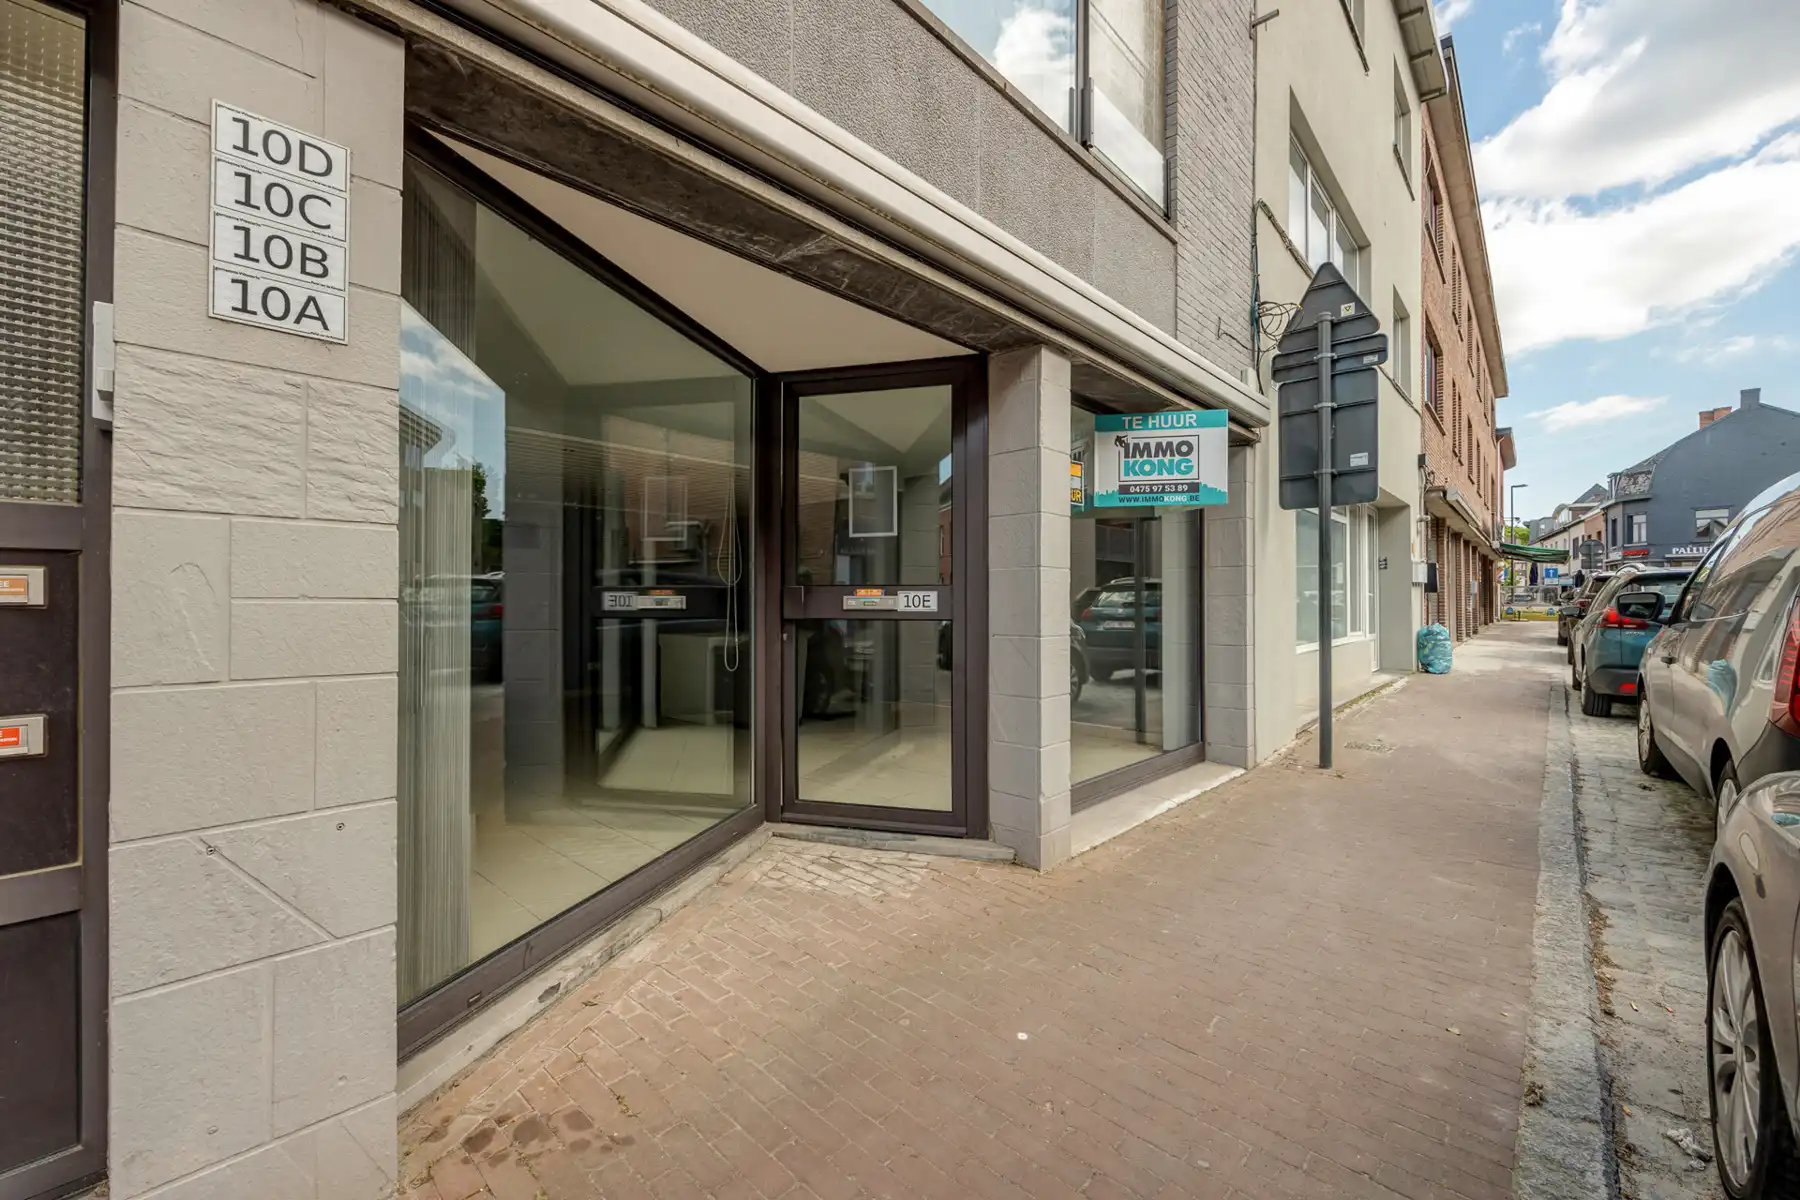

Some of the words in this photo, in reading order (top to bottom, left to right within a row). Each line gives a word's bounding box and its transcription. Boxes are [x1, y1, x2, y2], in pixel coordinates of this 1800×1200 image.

[232, 117, 332, 177] 10D
[234, 171, 331, 230] 10C
[233, 225, 329, 279] 10B
[231, 278, 330, 331] 10A
[1122, 417, 1142, 429] TE
[1148, 414, 1197, 428] HUUR
[1124, 441, 1194, 459] IMMO
[1124, 458, 1194, 476] KONG
[1129, 485, 1150, 493] 0475
[1177, 484, 1188, 492] 89
[904, 594, 931, 608] 10E
